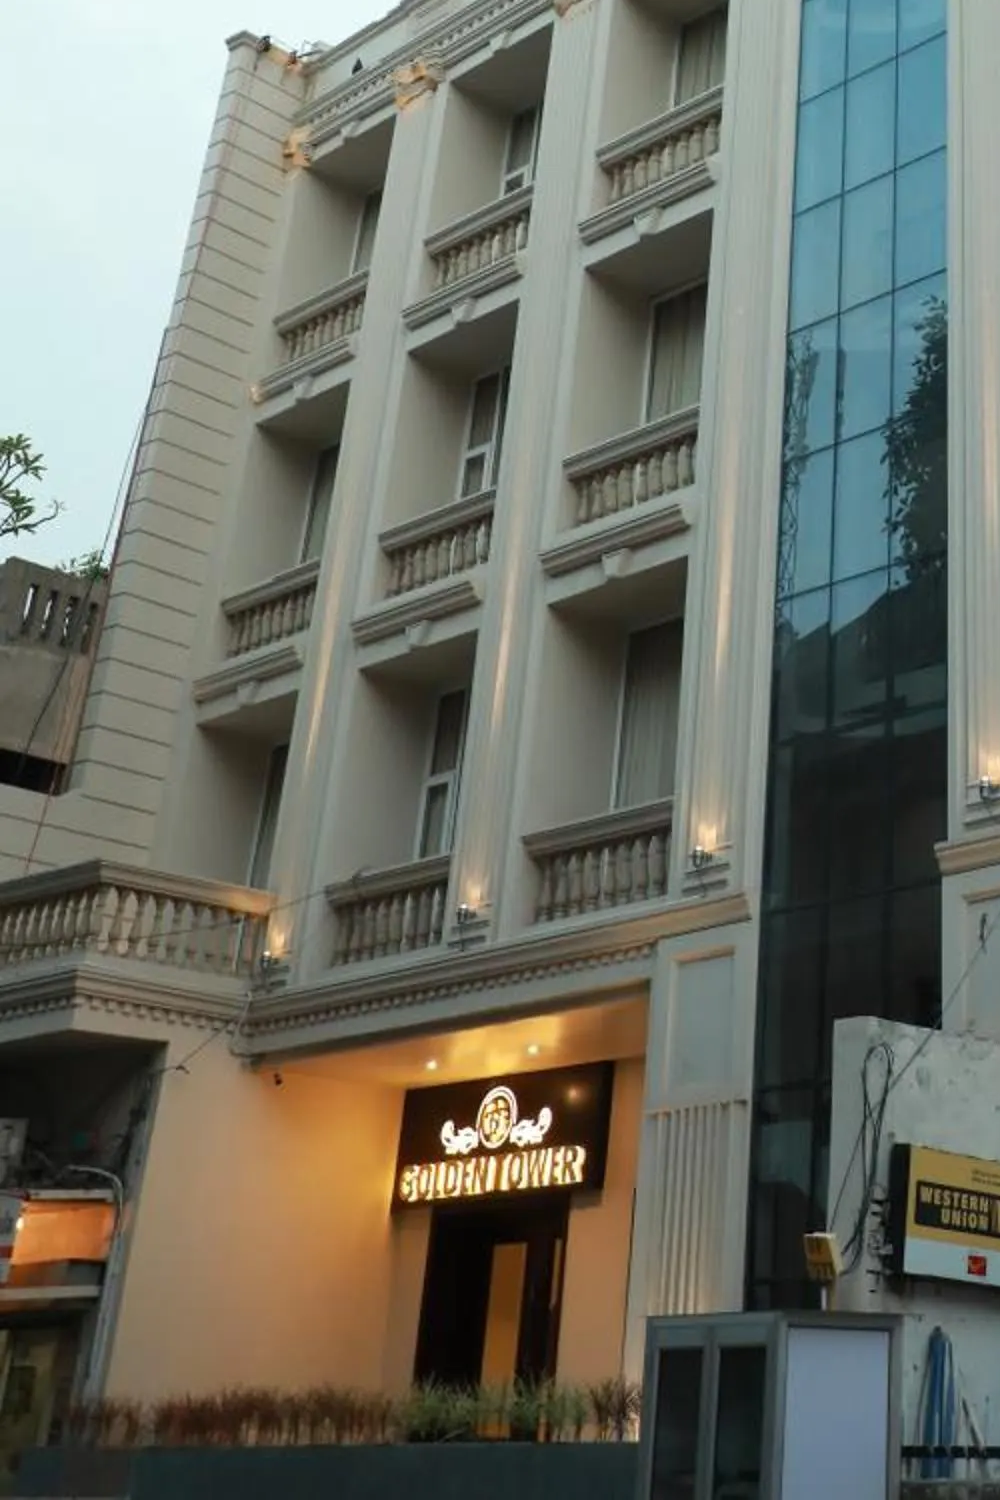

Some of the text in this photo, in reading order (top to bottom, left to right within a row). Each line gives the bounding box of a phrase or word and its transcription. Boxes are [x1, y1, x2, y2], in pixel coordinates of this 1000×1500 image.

[399, 1144, 587, 1203] GOLDEN TOWER
[919, 1186, 990, 1213] WESTERN
[940, 1208, 989, 1231] UNION
